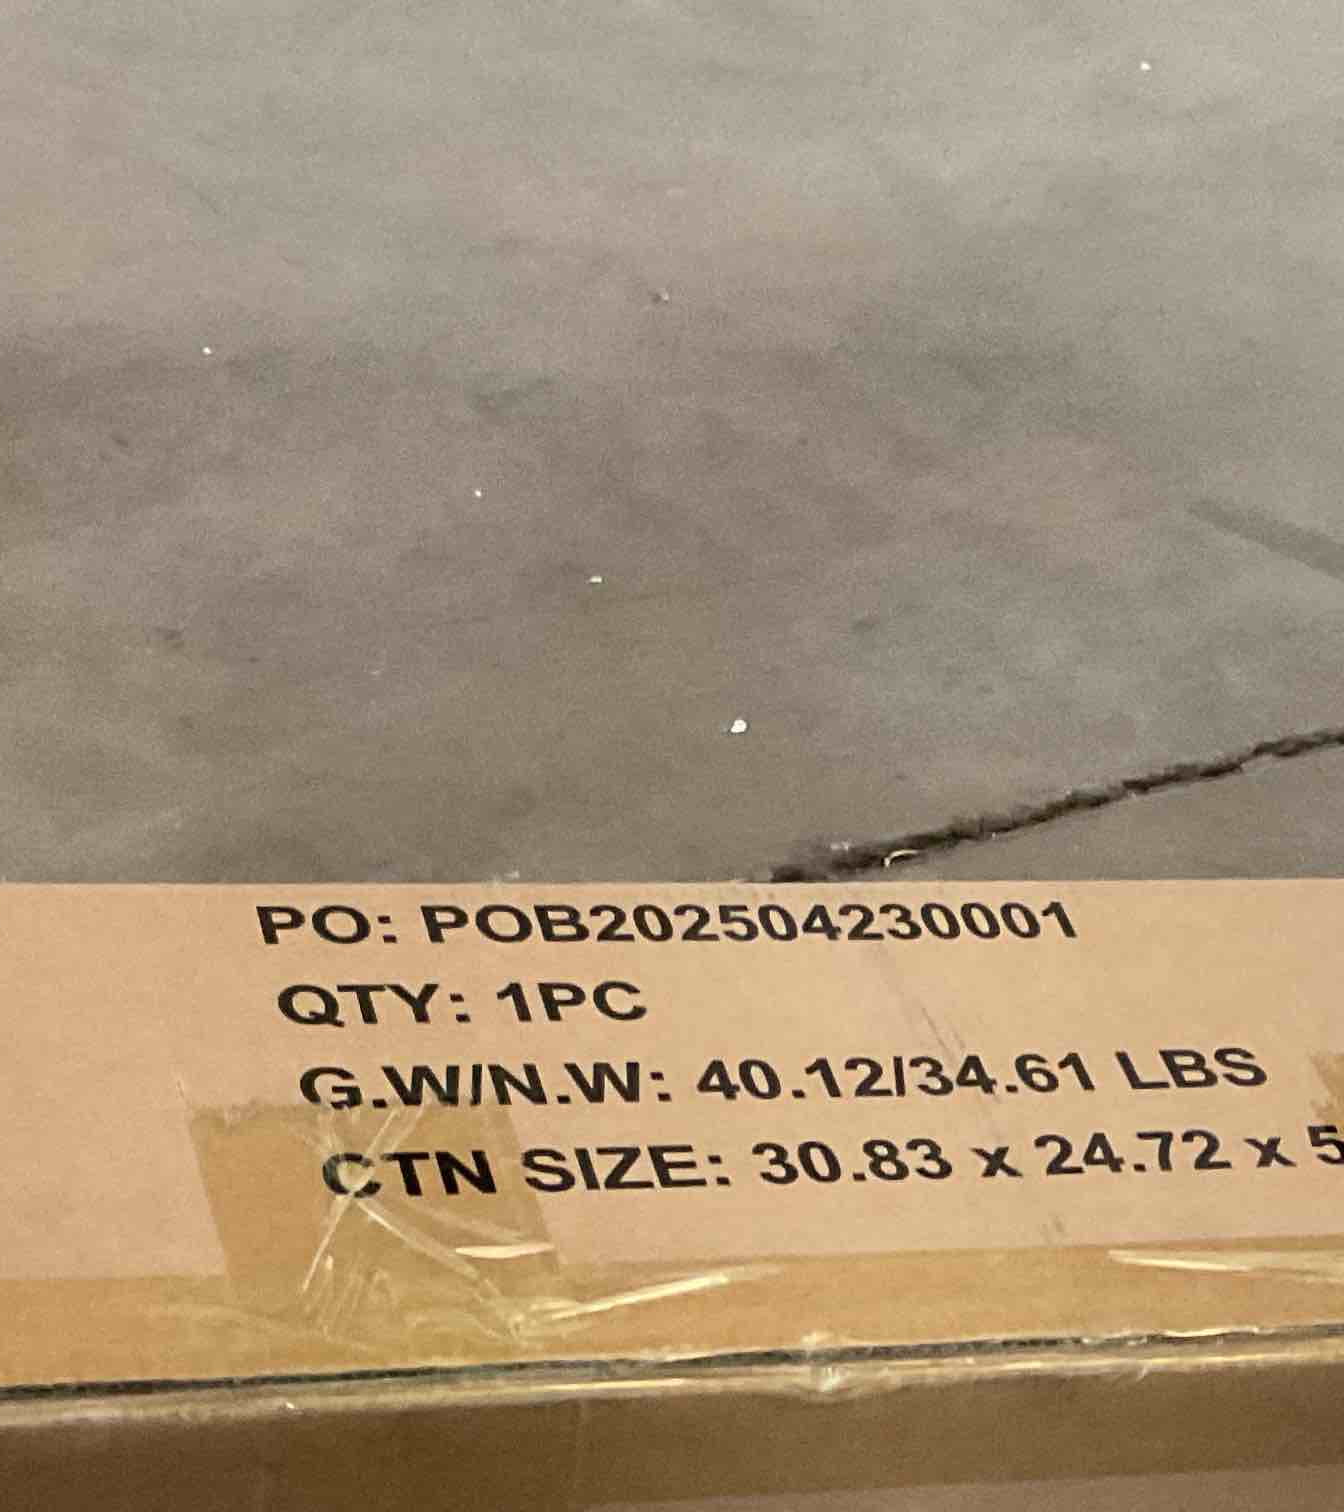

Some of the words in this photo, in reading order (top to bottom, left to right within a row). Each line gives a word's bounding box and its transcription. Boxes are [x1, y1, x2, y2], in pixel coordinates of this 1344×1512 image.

[255, 905, 397, 945] PO:
[420, 901, 1077, 944] POB202504230001
[277, 983, 471, 1028] QTY:
[496, 981, 647, 1023] 1PC
[299, 1057, 672, 1108] G.W/N.W:
[696, 1052, 1095, 1100] 40.12/34.61
[1115, 1047, 1268, 1090] LBS
[321, 1149, 498, 1199] CTN
[521, 1144, 731, 1193] SIZE:
[751, 1138, 953, 1185] 30.83
[972, 1146, 1023, 1178] x
[1034, 1129, 1233, 1176] 24.72
[1245, 1137, 1297, 1168] x
